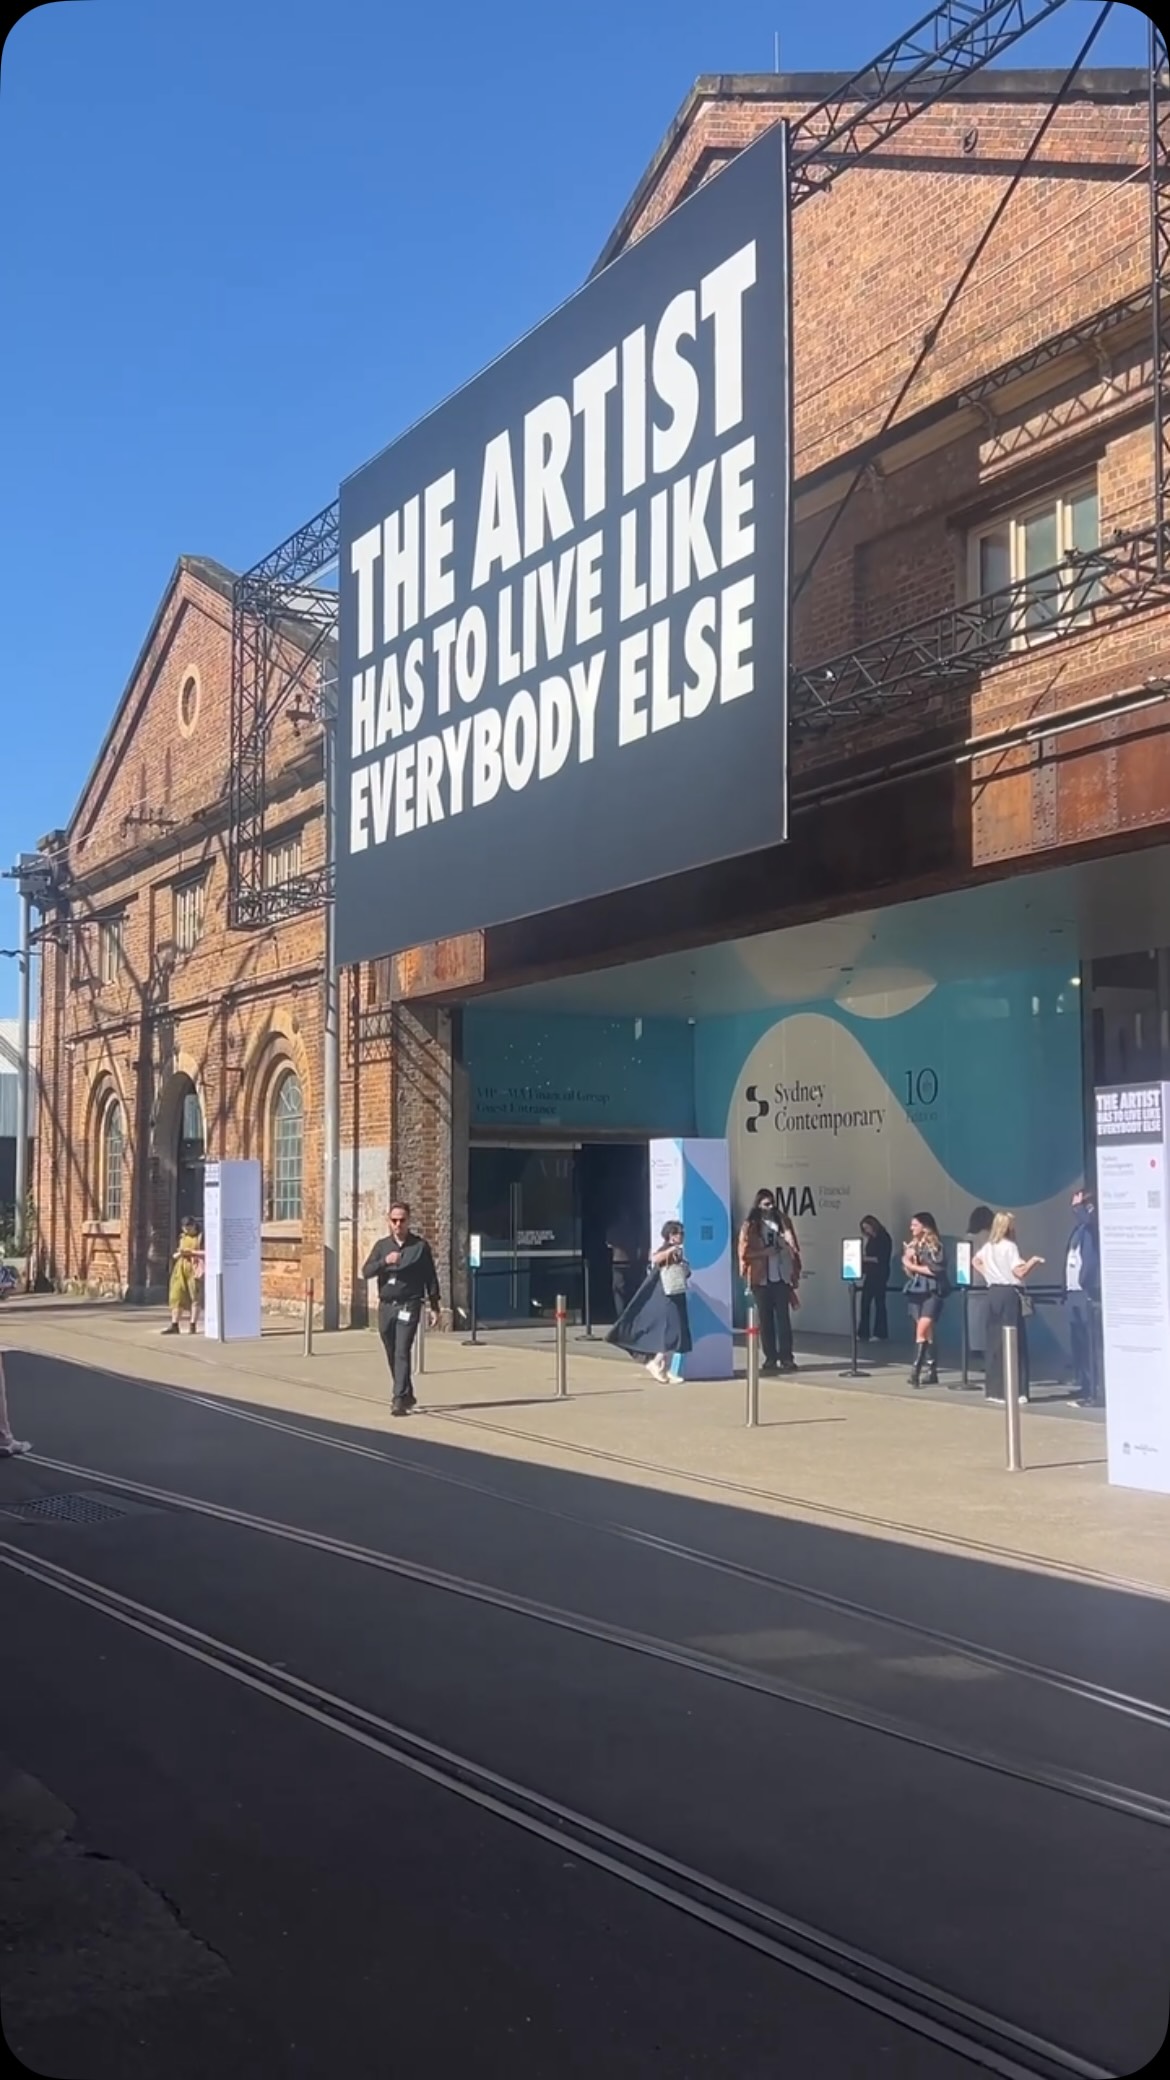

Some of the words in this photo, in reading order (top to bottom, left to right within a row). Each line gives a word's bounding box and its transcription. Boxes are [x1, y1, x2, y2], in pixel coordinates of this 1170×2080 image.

[351, 468, 456, 660] THE
[470, 239, 758, 592] ARTIST
[351, 637, 425, 760] HAS
[432, 605, 488, 716] TO
[497, 529, 604, 686] LIVE
[619, 435, 756, 623] LIKE
[350, 649, 607, 854] EVERYBODY
[618, 574, 756, 747] ELSE
[774, 1080, 826, 1110] Sydney
[1096, 1093, 1119, 1111] THE
[1120, 1090, 1161, 1109] ARTIST
[774, 1109, 886, 1136] Contemporary
[776, 1186, 817, 1217] MA
